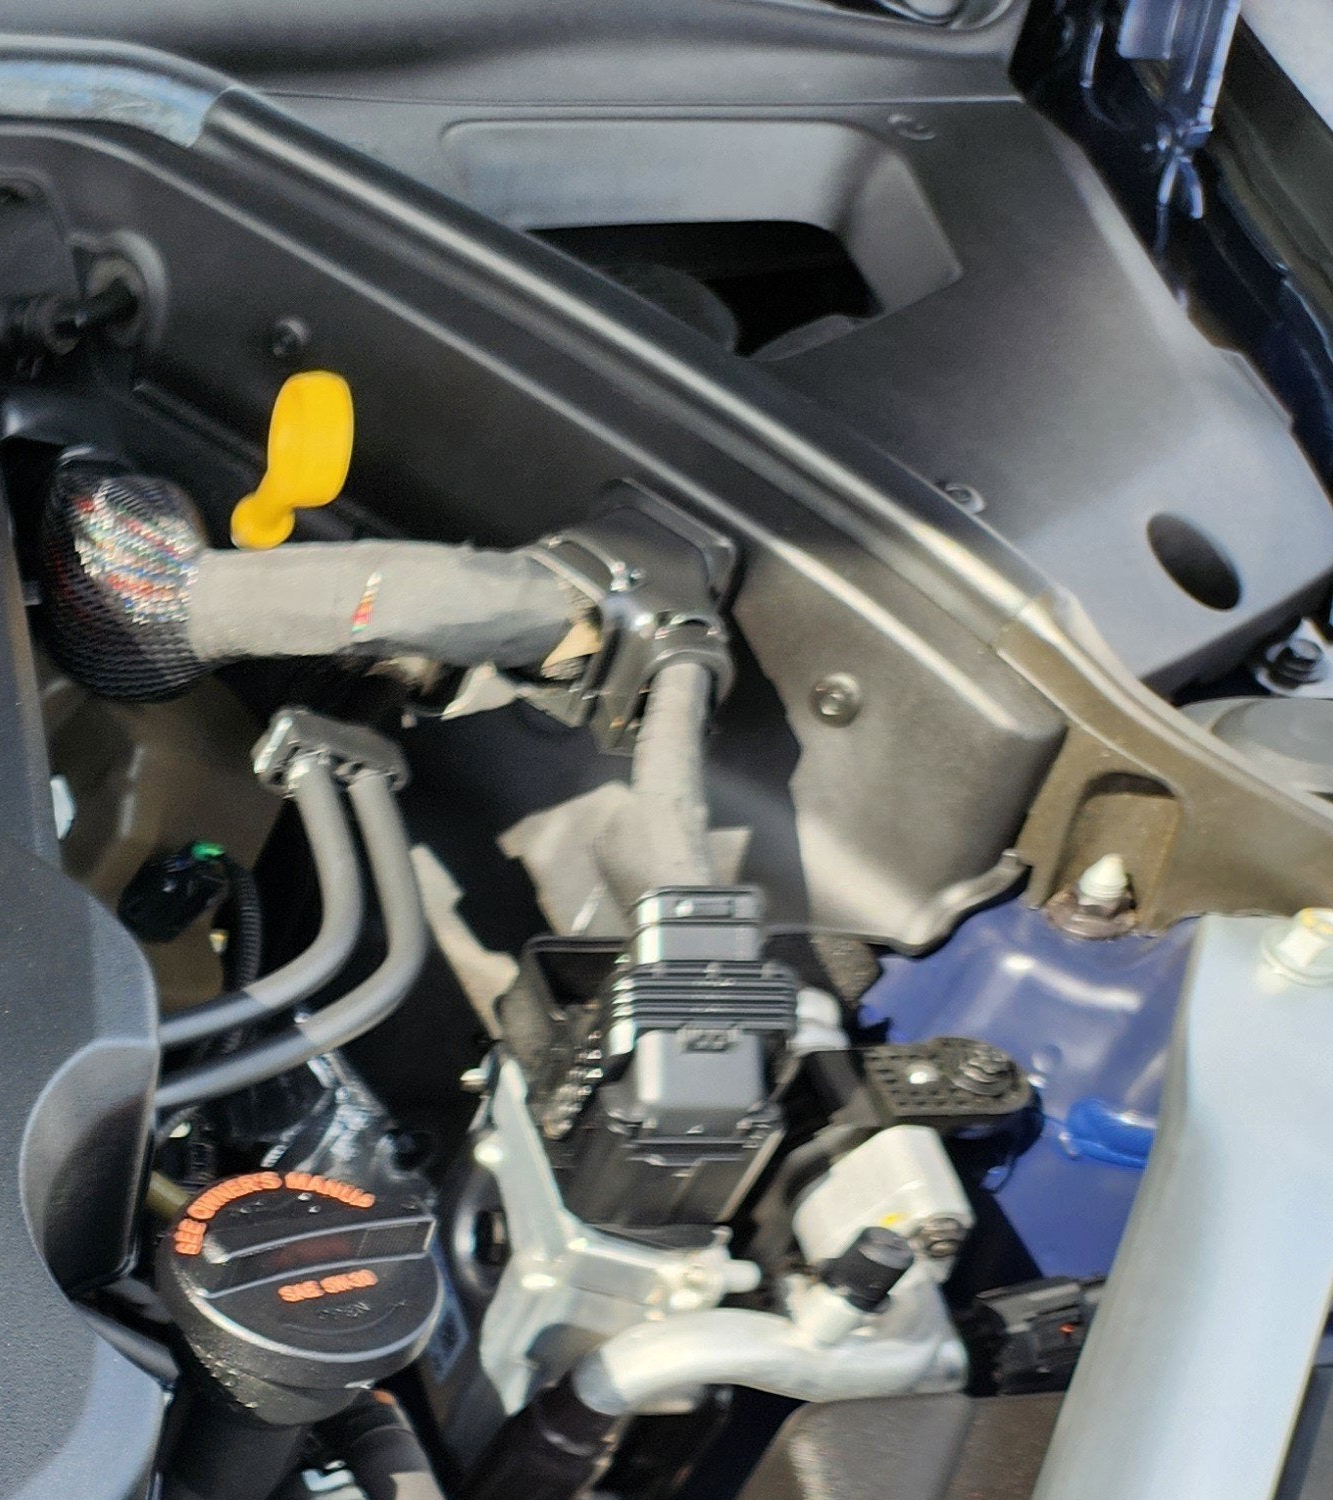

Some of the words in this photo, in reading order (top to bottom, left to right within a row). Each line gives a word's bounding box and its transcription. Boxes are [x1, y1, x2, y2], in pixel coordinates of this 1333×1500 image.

[186, 1171, 284, 1221] OWNER'S
[283, 1171, 375, 1209] MANUAL
[173, 1218, 208, 1256] SEE
